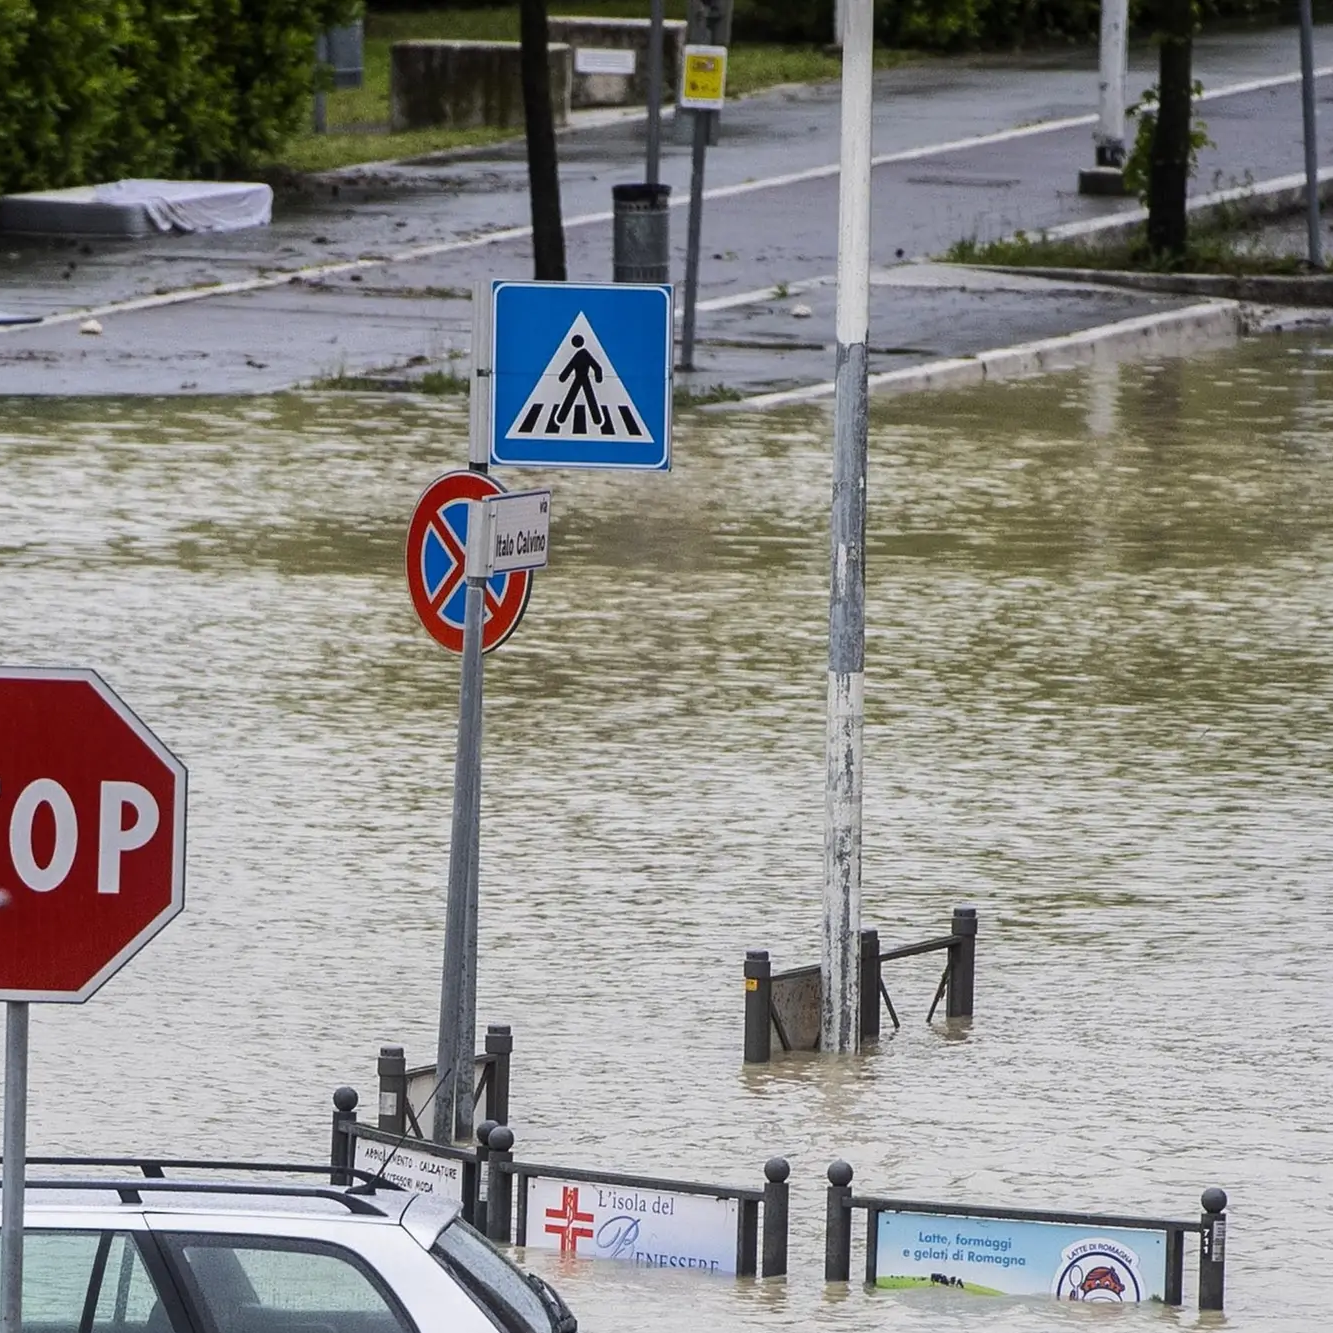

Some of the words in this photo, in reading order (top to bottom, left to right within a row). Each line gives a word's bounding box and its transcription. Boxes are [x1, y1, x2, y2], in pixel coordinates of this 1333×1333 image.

[540, 497, 548, 514] via
[496, 533, 514, 557] Italo
[516, 529, 546, 555] Calvino
[419, 1161, 458, 1180] CALZATURE
[415, 1182, 434, 1193] MODA
[598, 1190, 646, 1212] L'isola
[652, 1197, 674, 1215] del
[918, 1231, 952, 1246] Latte,
[955, 1233, 1012, 1252] formaggi
[903, 1248, 910, 1257] e
[914, 1247, 948, 1261] gelati
[952, 1249, 964, 1261] di
[967, 1251, 1026, 1268] Romagna
[1067, 1245, 1087, 1260] LATTE
[1098, 1243, 1132, 1264] ROMAGNA
